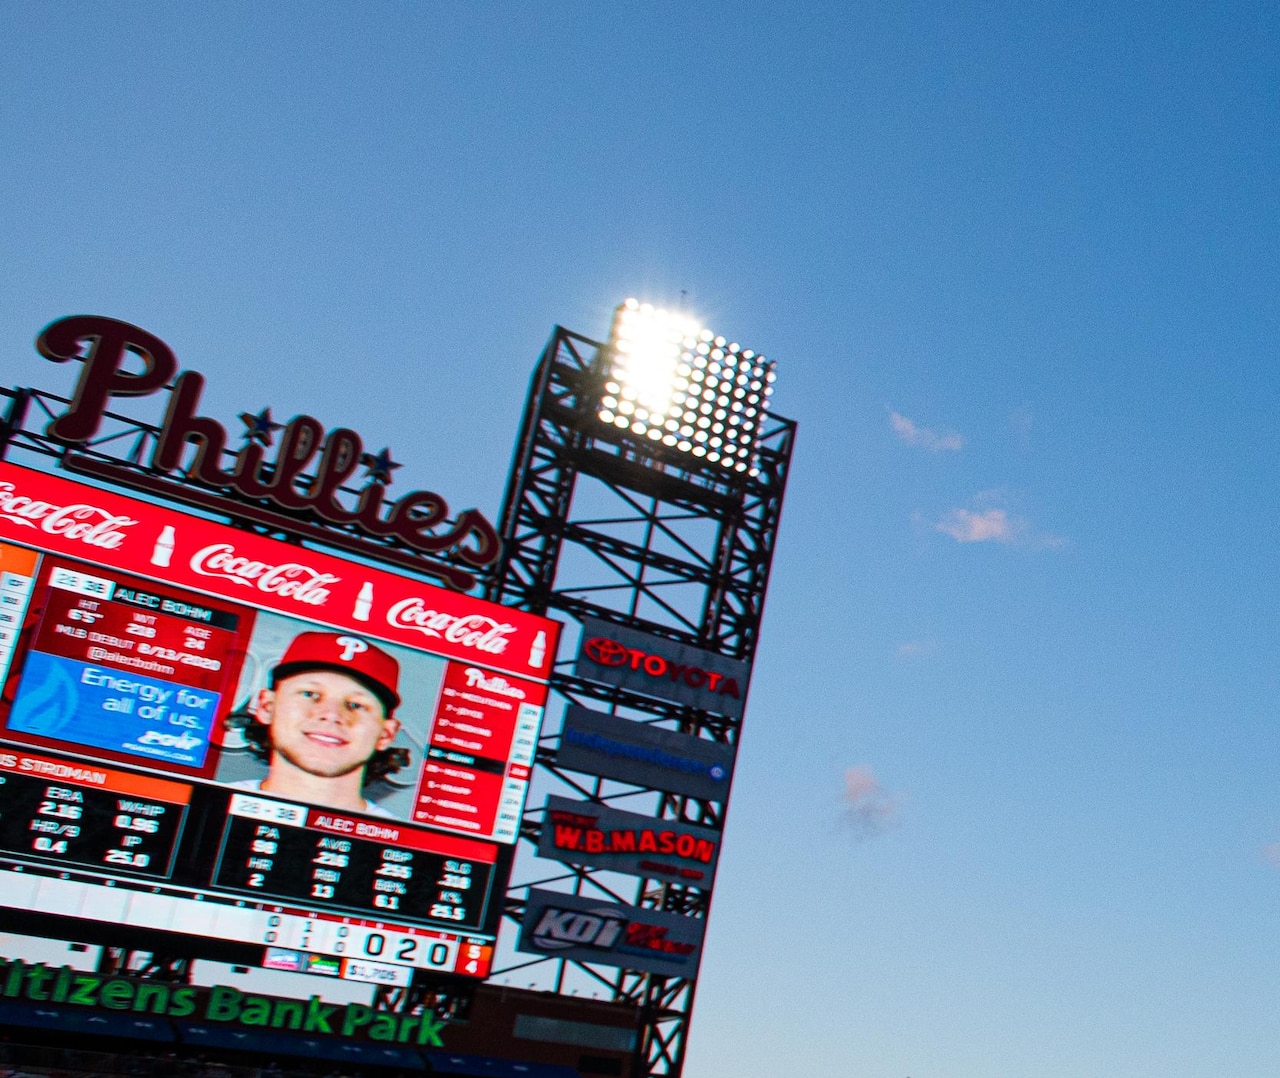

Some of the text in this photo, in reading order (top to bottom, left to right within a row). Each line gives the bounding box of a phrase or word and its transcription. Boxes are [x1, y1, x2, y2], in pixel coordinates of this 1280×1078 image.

[36, 315, 501, 570] Phillies
[114, 588, 213, 622] ALEC BOHM
[189, 542, 339, 608] Coca-Cola
[386, 597, 518, 655] Coca-Cola
[88, 631, 136, 651] DEBUT
[137, 643, 222, 671] 8/13/2020
[81, 667, 212, 711] Energy for
[627, 649, 741, 700] TOYOTA
[102, 696, 205, 730] all of us.
[18, 758, 106, 785] STROMAN
[38, 801, 83, 820] 2.16
[45, 786, 165, 817] ERA WHIP
[30, 819, 142, 848] HR/9 IP
[314, 815, 400, 842] ALEC BOHM
[32, 837, 151, 868] 0.4 25.0
[254, 825, 472, 876] PA AVG OBP SLG
[247, 857, 273, 872] HR
[312, 868, 341, 884] RBI
[310, 883, 335, 899] 13
[366, 933, 449, 967] 0 2 0
[205, 984, 334, 1035] Bank
[341, 1002, 446, 1049] Park
